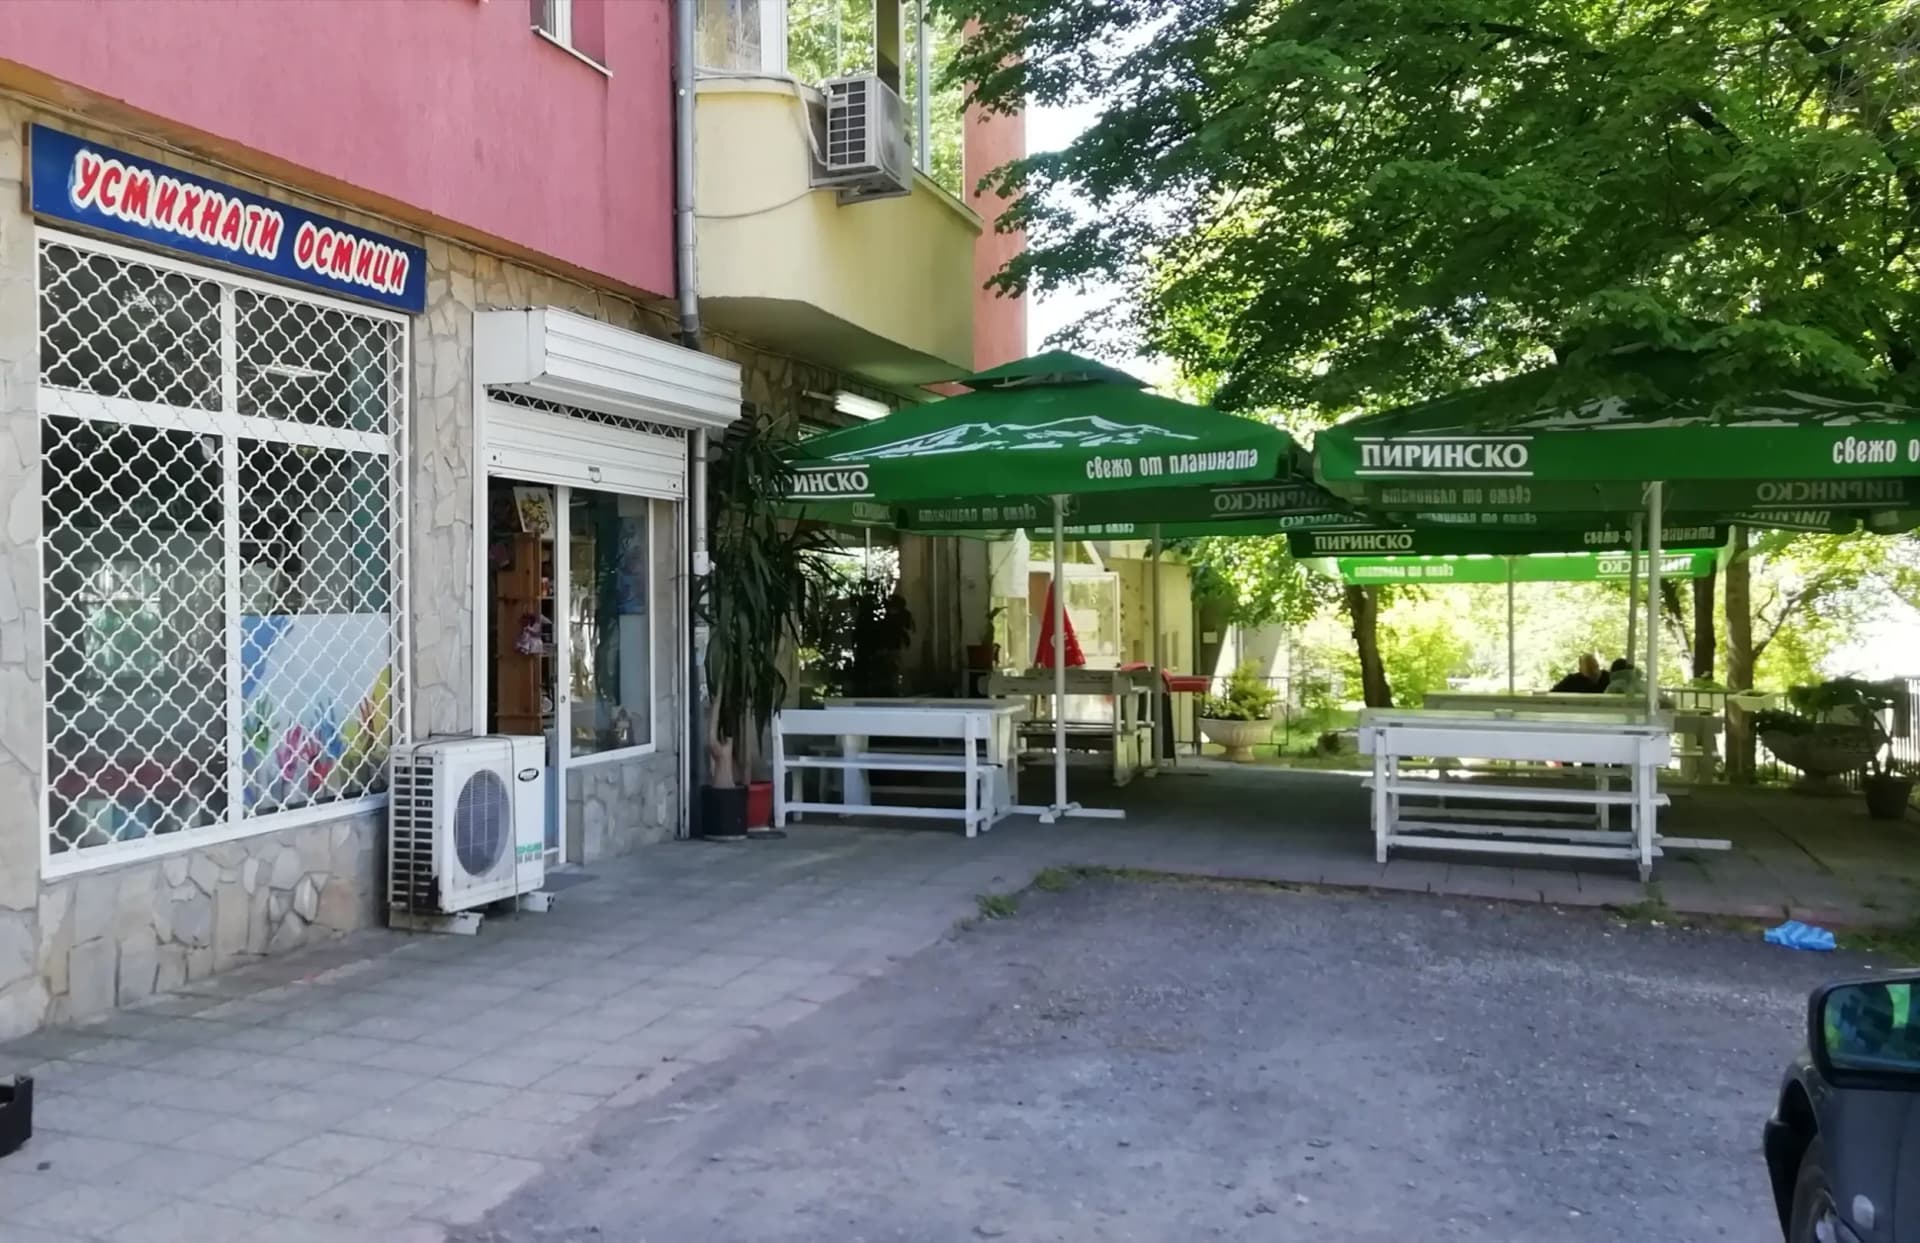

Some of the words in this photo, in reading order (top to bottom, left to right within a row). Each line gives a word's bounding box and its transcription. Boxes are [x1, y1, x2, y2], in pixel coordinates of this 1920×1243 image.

[73, 149, 284, 260] УСМИХНАТИ
[295, 221, 409, 295] ОСМИЦИ
[1086, 456, 1132, 479] свежо
[1139, 456, 1163, 476] от
[1169, 448, 1258, 475] планината
[1361, 443, 1529, 468] ПИРИНСКО
[1832, 436, 1897, 464] свежо
[1314, 534, 1413, 551] ПИРИНСКО
